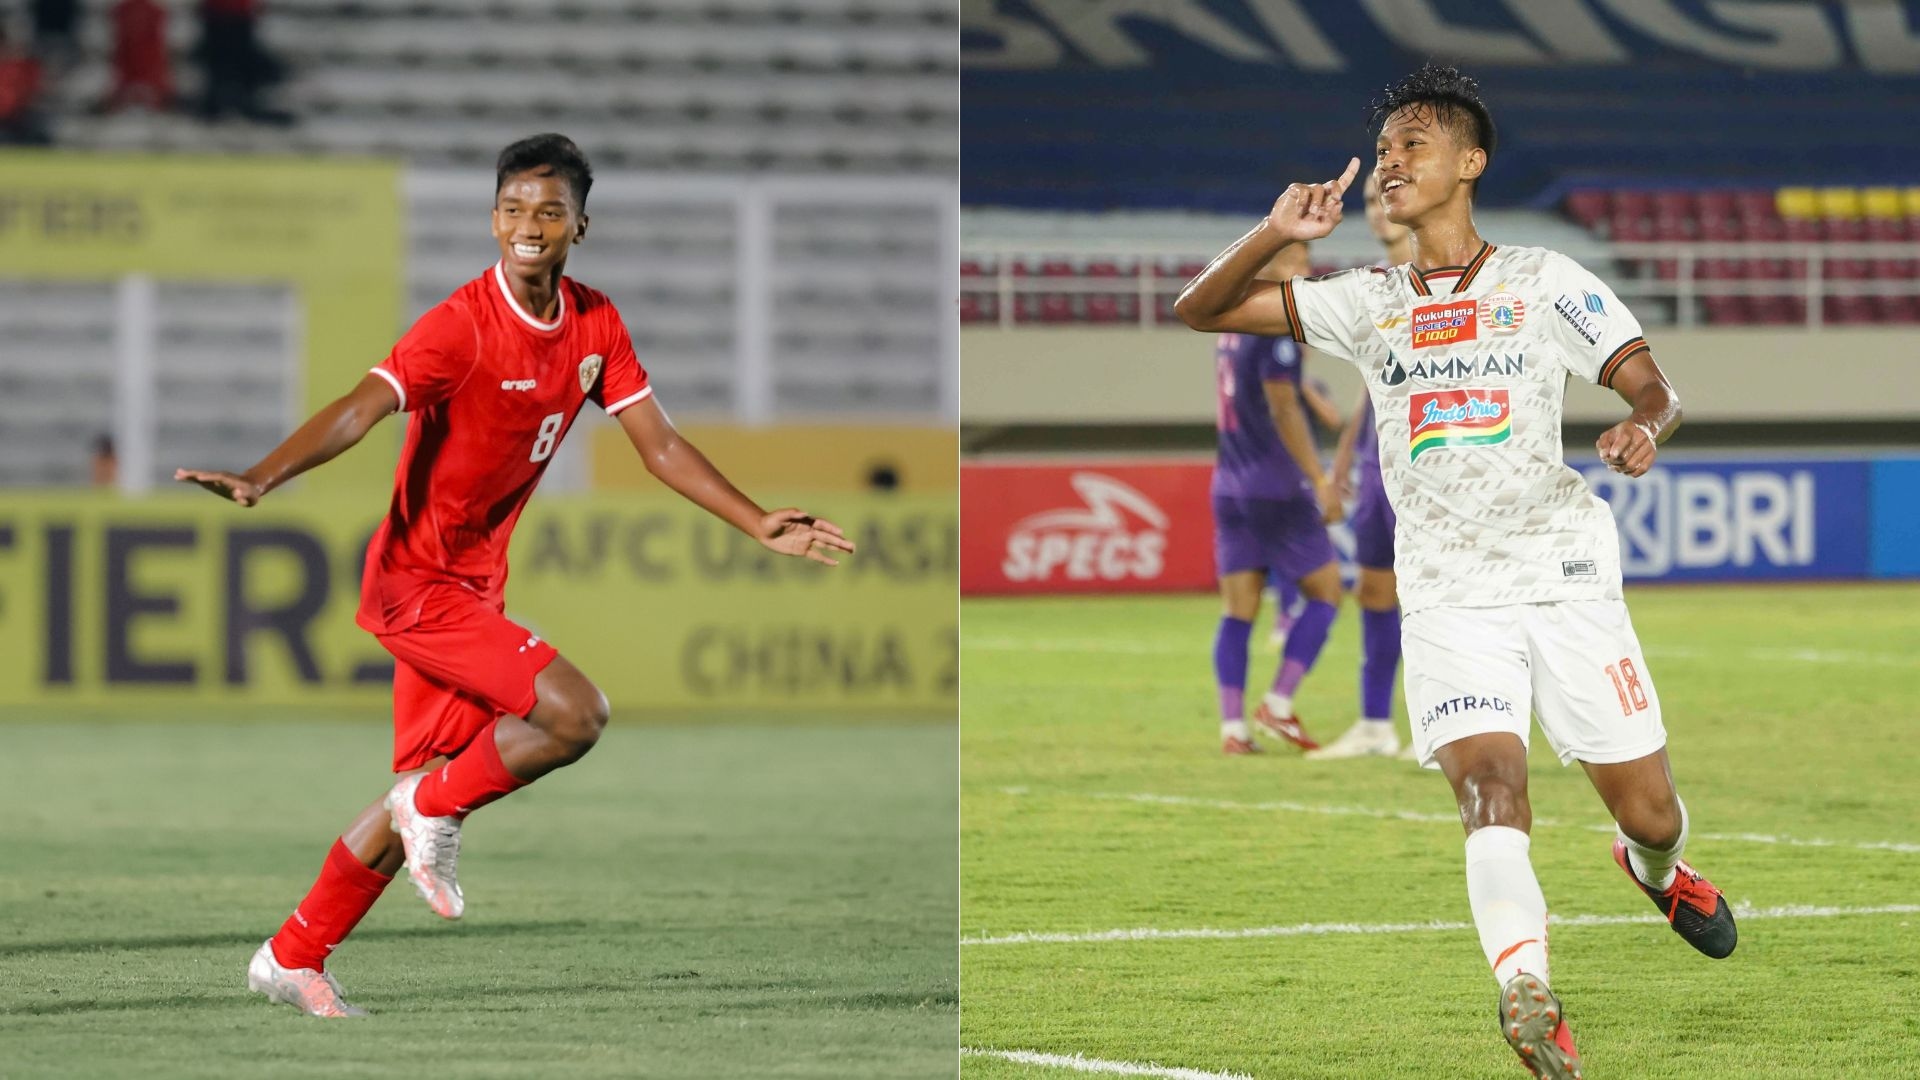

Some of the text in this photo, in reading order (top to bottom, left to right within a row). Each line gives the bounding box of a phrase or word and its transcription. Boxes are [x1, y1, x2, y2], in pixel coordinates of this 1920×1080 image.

[1414, 328, 1460, 344] C1000
[1415, 307, 1475, 324] KukuBima
[1558, 294, 1602, 341] ITHACA
[501, 378, 537, 392] erspo
[1409, 353, 1524, 379] AMMAN
[529, 411, 564, 463] 8
[1674, 472, 1816, 567] BRI
[527, 512, 674, 583] AFC
[1002, 529, 1167, 582] SPECS
[681, 623, 914, 695] CHINA
[1604, 656, 1649, 718] 18
[1421, 695, 1514, 732] SAMTRADE
